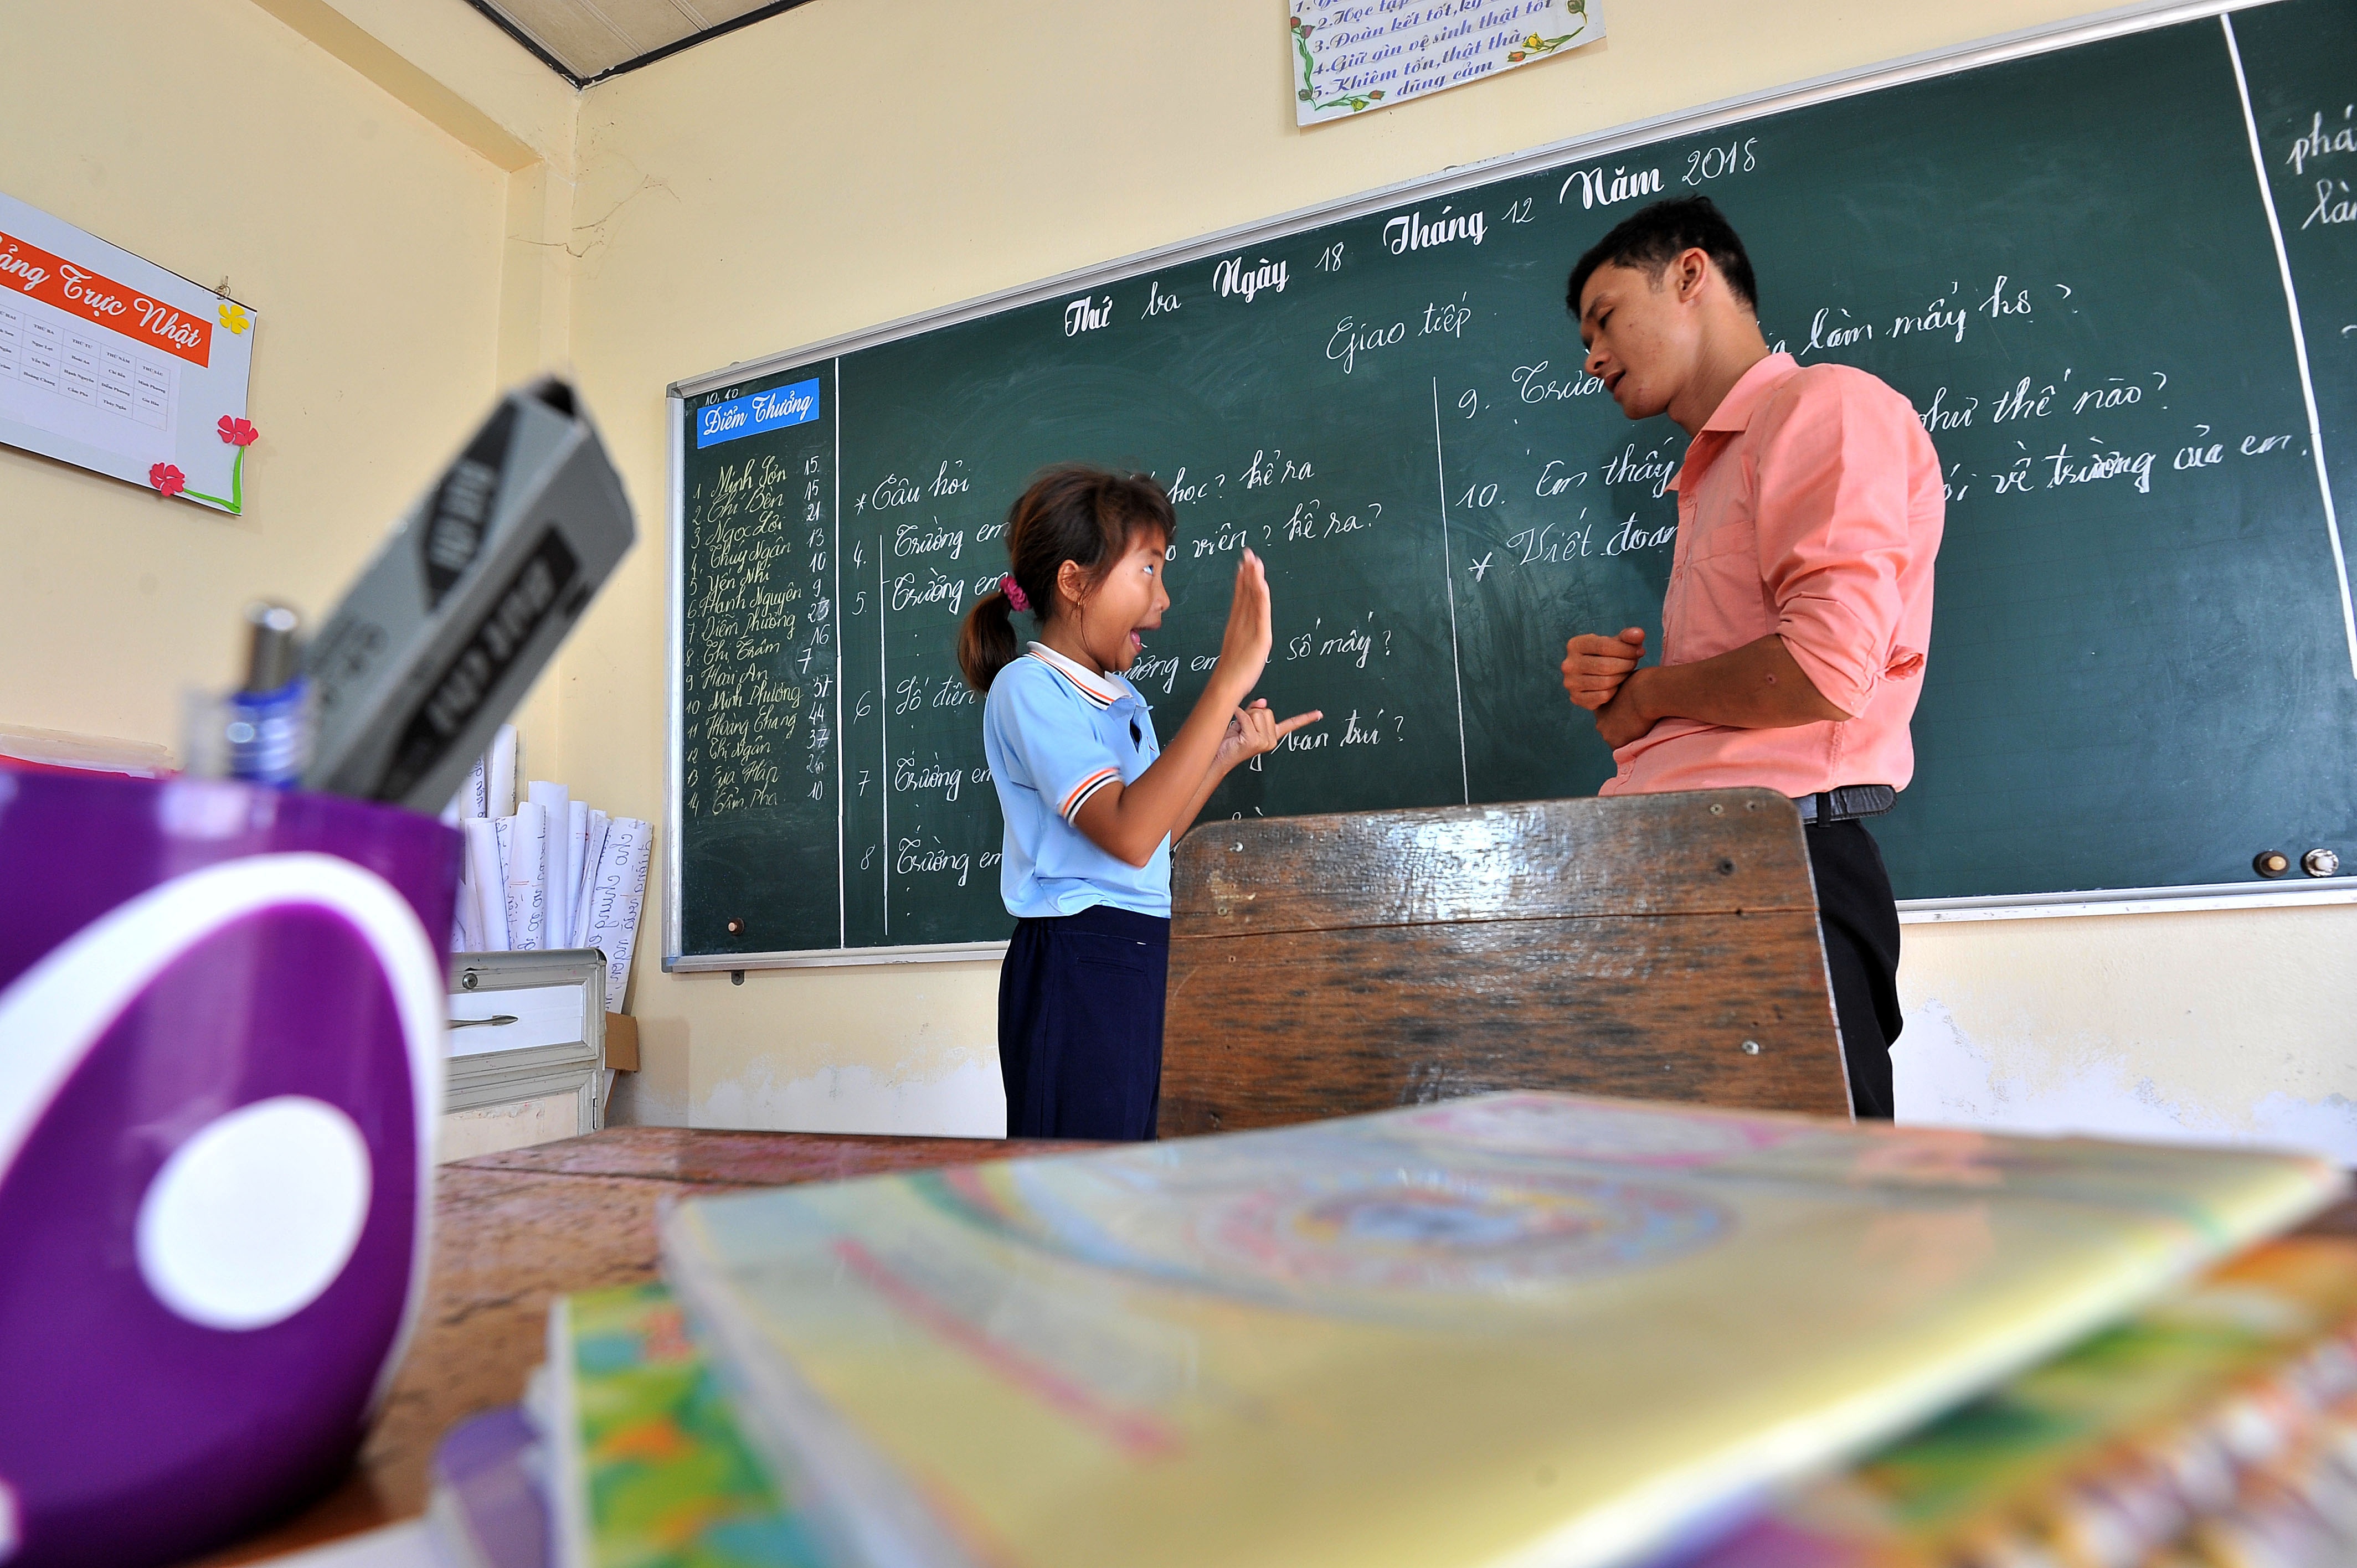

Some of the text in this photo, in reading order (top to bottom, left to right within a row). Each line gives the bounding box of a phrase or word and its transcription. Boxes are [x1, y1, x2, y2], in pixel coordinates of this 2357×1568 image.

[1372, 44, 1402, 61] gìn
[1408, 34, 1429, 51] vệ
[1433, 19, 1471, 43] sinh
[1479, 4, 1519, 29] thật
[1391, 12, 1419, 31] kết
[1442, 40, 1481, 63] thật
[1397, 61, 1493, 96] dũng cảm
[1064, 296, 1113, 338] Thứ
[1141, 281, 1181, 321] ba
[1213, 255, 1290, 303] Ngày
[1314, 243, 1345, 272] 18
[1383, 205, 1489, 255] Tháng
[1501, 197, 1536, 223] 12
[1559, 166, 1665, 210] Năm
[0, 235, 202, 349] ảng Trực Nhật
[1326, 291, 1471, 375] Giao tiếp
[1511, 360, 1605, 404] Trườ
[703, 390, 814, 436] Điểm Thưởng
[1536, 460, 1587, 497] Em
[1601, 436, 1675, 499] thấy
[1992, 368, 2071, 424] thế
[711, 458, 754, 497] Minh
[872, 460, 971, 510] Câu hỏi
[1991, 440, 2034, 494] về
[2041, 436, 2157, 494] trường
[805, 479, 819, 501] 15
[894, 515, 964, 560] Trường
[1239, 450, 1281, 489] kể
[1280, 460, 1315, 484] ra
[691, 527, 701, 549] 3
[806, 502, 821, 522] 21
[740, 560, 771, 585] Nhi
[809, 551, 826, 572] 10
[749, 536, 791, 571] Ngân
[806, 528, 825, 548] 13
[892, 567, 965, 616] Trường
[1283, 499, 1320, 541] kể
[749, 581, 802, 617] Nguyên
[812, 579, 822, 597] 9
[686, 648, 694, 667] 8
[736, 638, 780, 661] Trâm
[810, 624, 830, 646] 16
[687, 622, 695, 644] 7
[701, 614, 738, 641] Diễm
[740, 607, 796, 640] Phương
[686, 674, 693, 691] 9
[739, 663, 769, 683] An
[797, 648, 813, 674] 7
[853, 690, 871, 725] 6
[896, 675, 930, 715] Số
[932, 675, 976, 713] điện
[1286, 618, 1321, 661] số
[686, 700, 700, 714] 10
[708, 683, 742, 711] Minh
[747, 679, 804, 708] Phương
[687, 723, 698, 740] 11
[705, 712, 749, 740] Hoàng
[808, 701, 825, 725] 44
[730, 734, 771, 766] Ngân
[807, 780, 823, 801] 10
[858, 770, 871, 797] 7
[894, 751, 964, 802] Trường
[860, 843, 876, 870] 8
[896, 834, 970, 887] Trường
